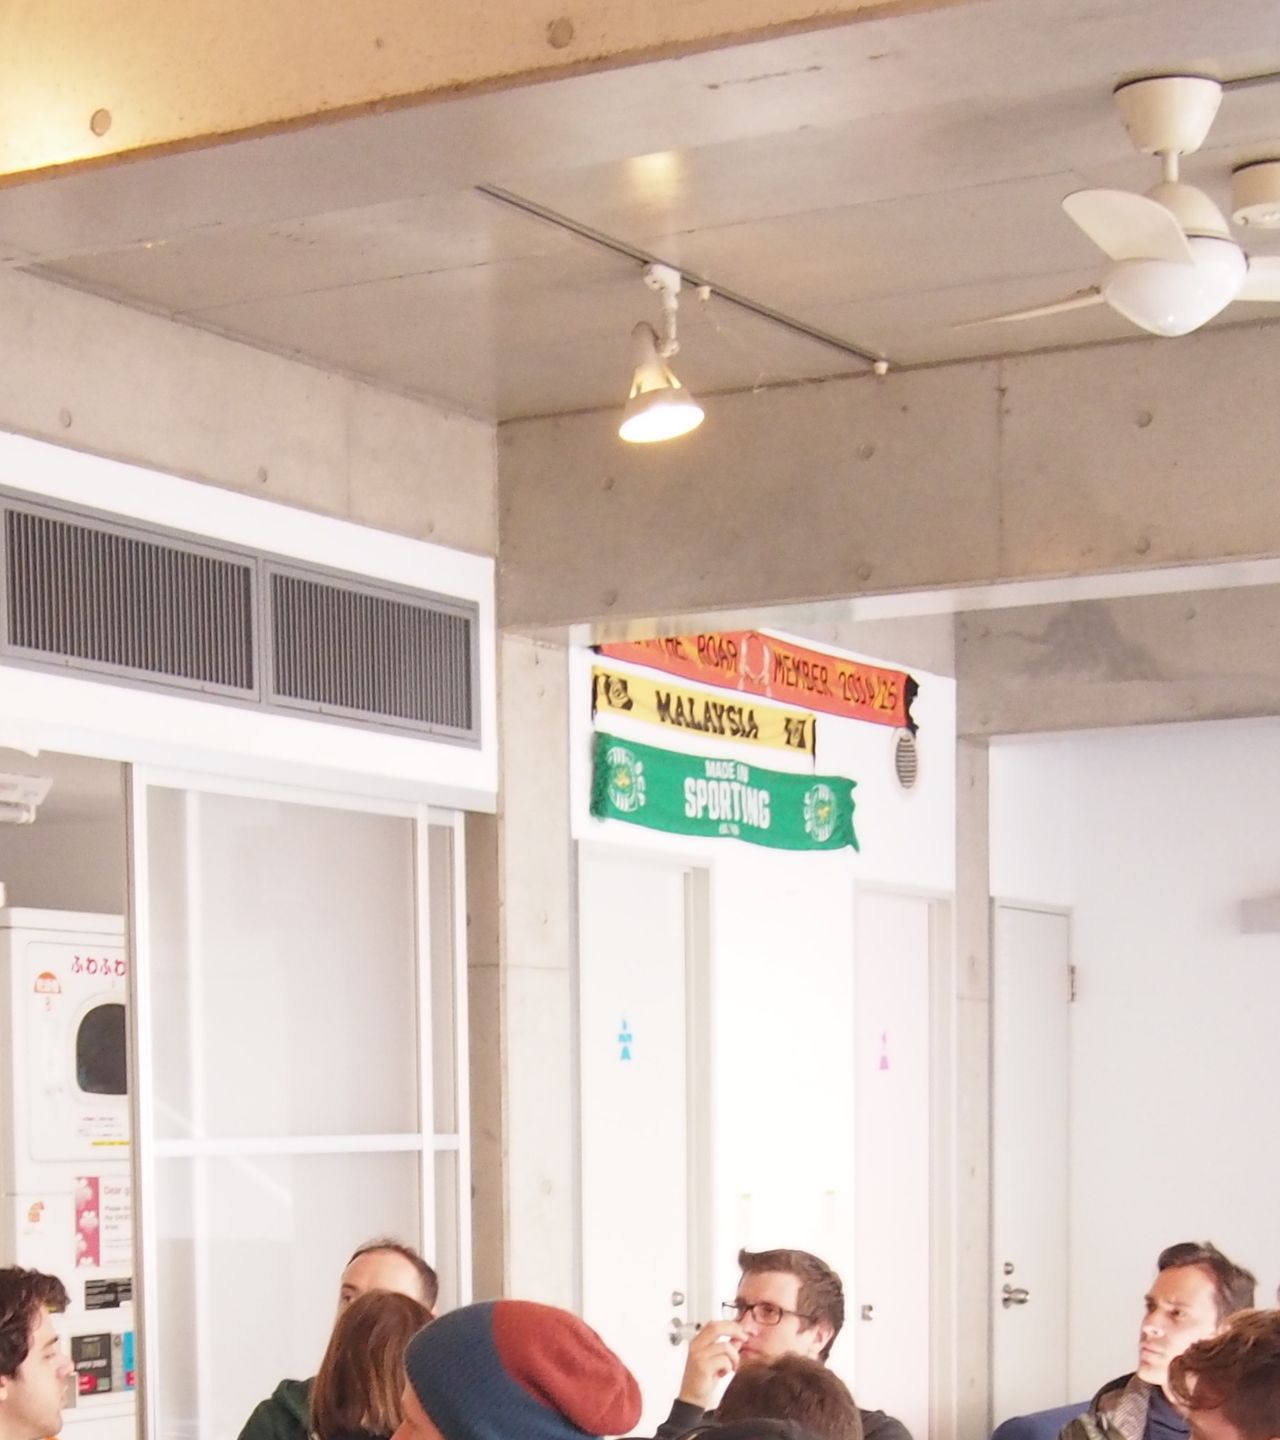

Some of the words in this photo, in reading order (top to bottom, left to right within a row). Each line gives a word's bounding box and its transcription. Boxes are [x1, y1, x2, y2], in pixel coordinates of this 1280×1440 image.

[696, 634, 738, 673] ROAR
[773, 649, 833, 698] MEMBER
[655, 689, 760, 740] MALAYSIA
[705, 759, 736, 780] MADE
[736, 763, 749, 784] IN
[683, 777, 770, 829] SPORTING
